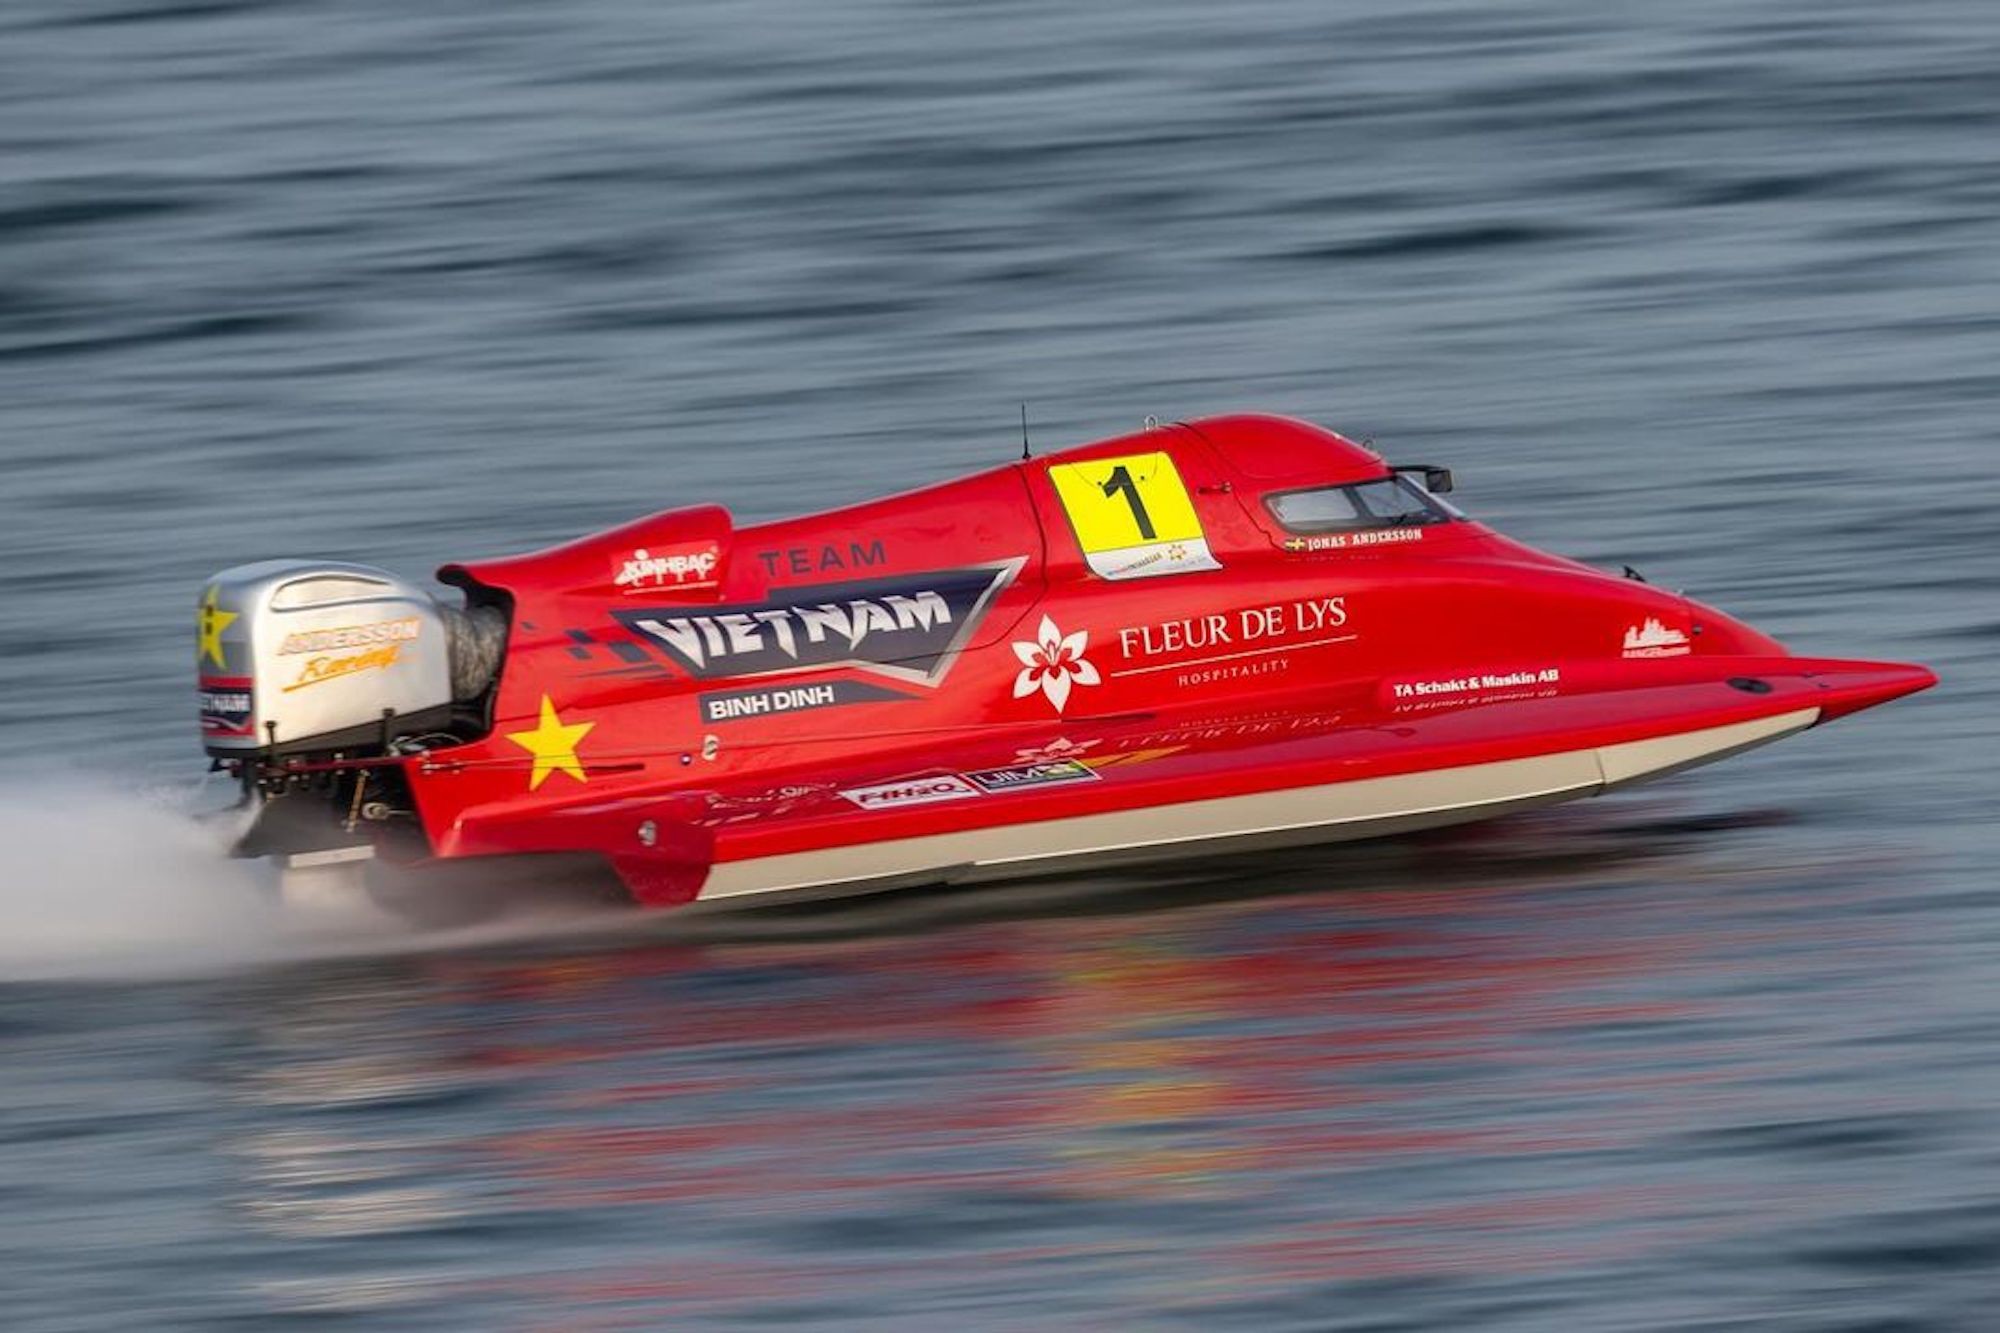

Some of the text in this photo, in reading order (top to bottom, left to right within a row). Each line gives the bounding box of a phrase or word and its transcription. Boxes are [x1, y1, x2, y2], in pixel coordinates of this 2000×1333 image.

[1102, 466, 1156, 540] 1
[1308, 529, 1423, 551] JONAS ANDERSSON
[758, 540, 887, 578] TEAM
[635, 590, 952, 669] VIETNAM
[1118, 597, 1347, 659] FLEUR DE LYS
[1178, 659, 1290, 687] HOSPITALITY
[1394, 669, 1559, 697] TA Schakt & Maskin AB
[708, 685, 835, 720] BINH DINH
